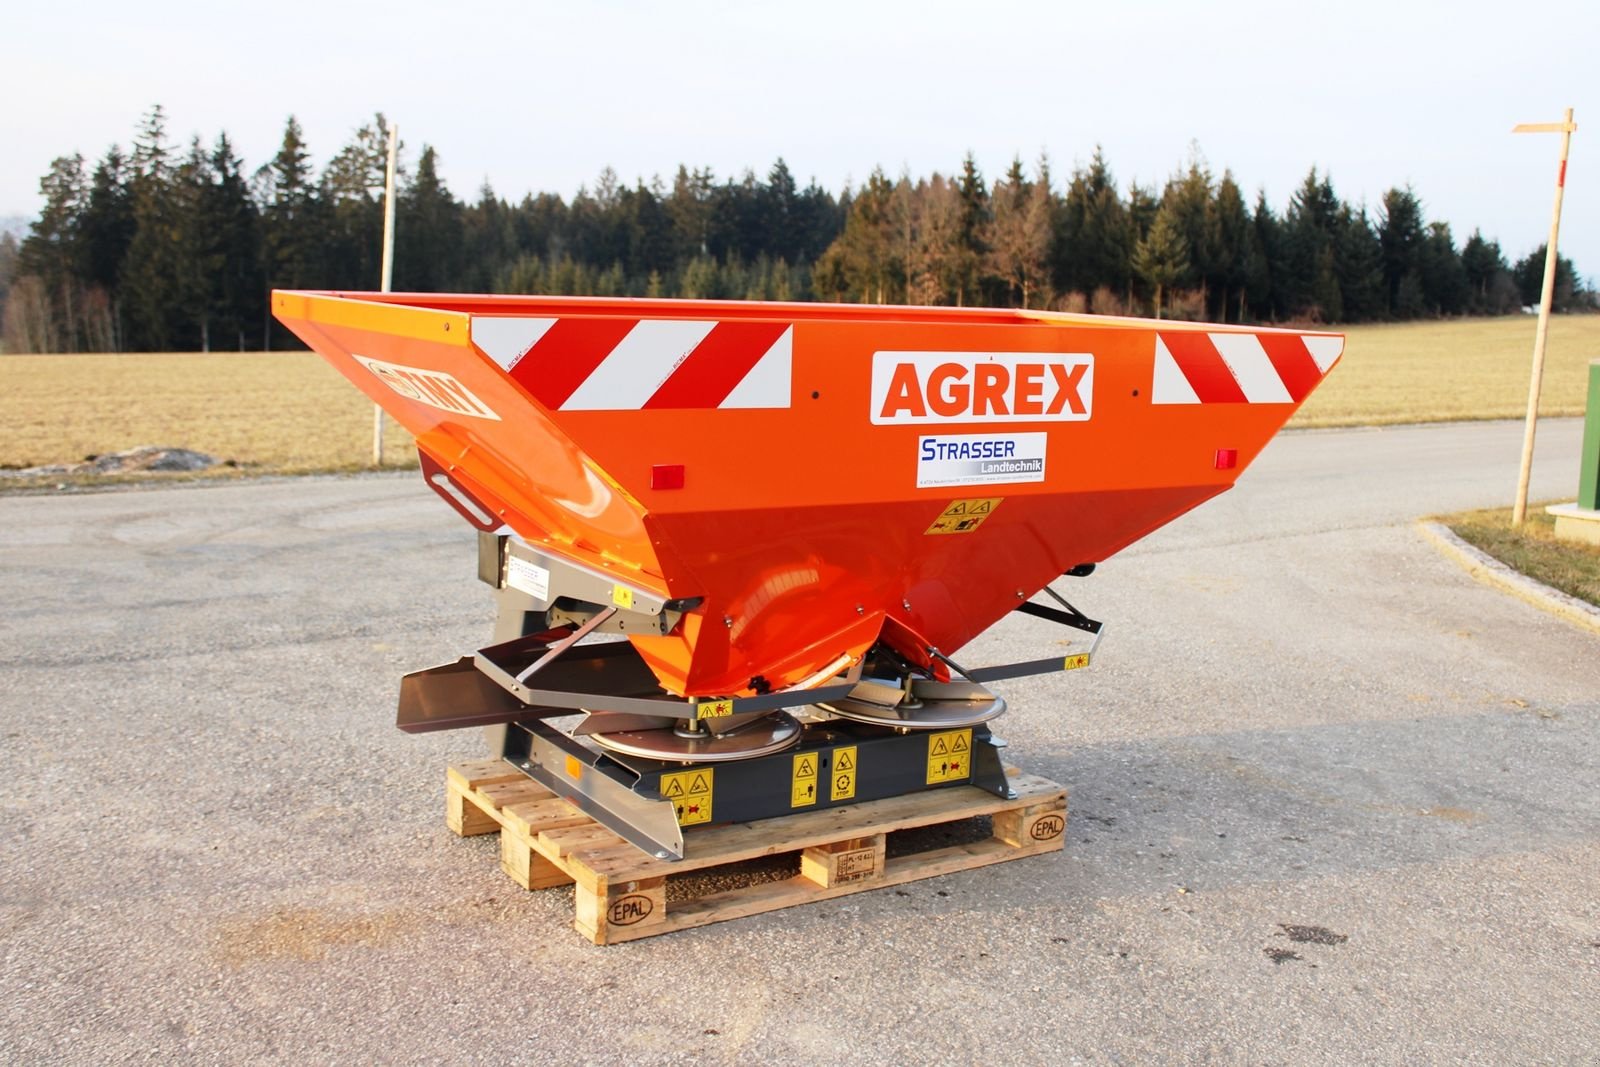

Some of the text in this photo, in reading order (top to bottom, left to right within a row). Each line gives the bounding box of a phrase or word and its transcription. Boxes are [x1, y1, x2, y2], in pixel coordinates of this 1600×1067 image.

[879, 362, 1090, 418] AGREX
[921, 438, 1016, 461] STRASSER
[980, 459, 1042, 474] Landtechnik
[1036, 820, 1060, 837] EPAL
[613, 900, 647, 922] EPAL
